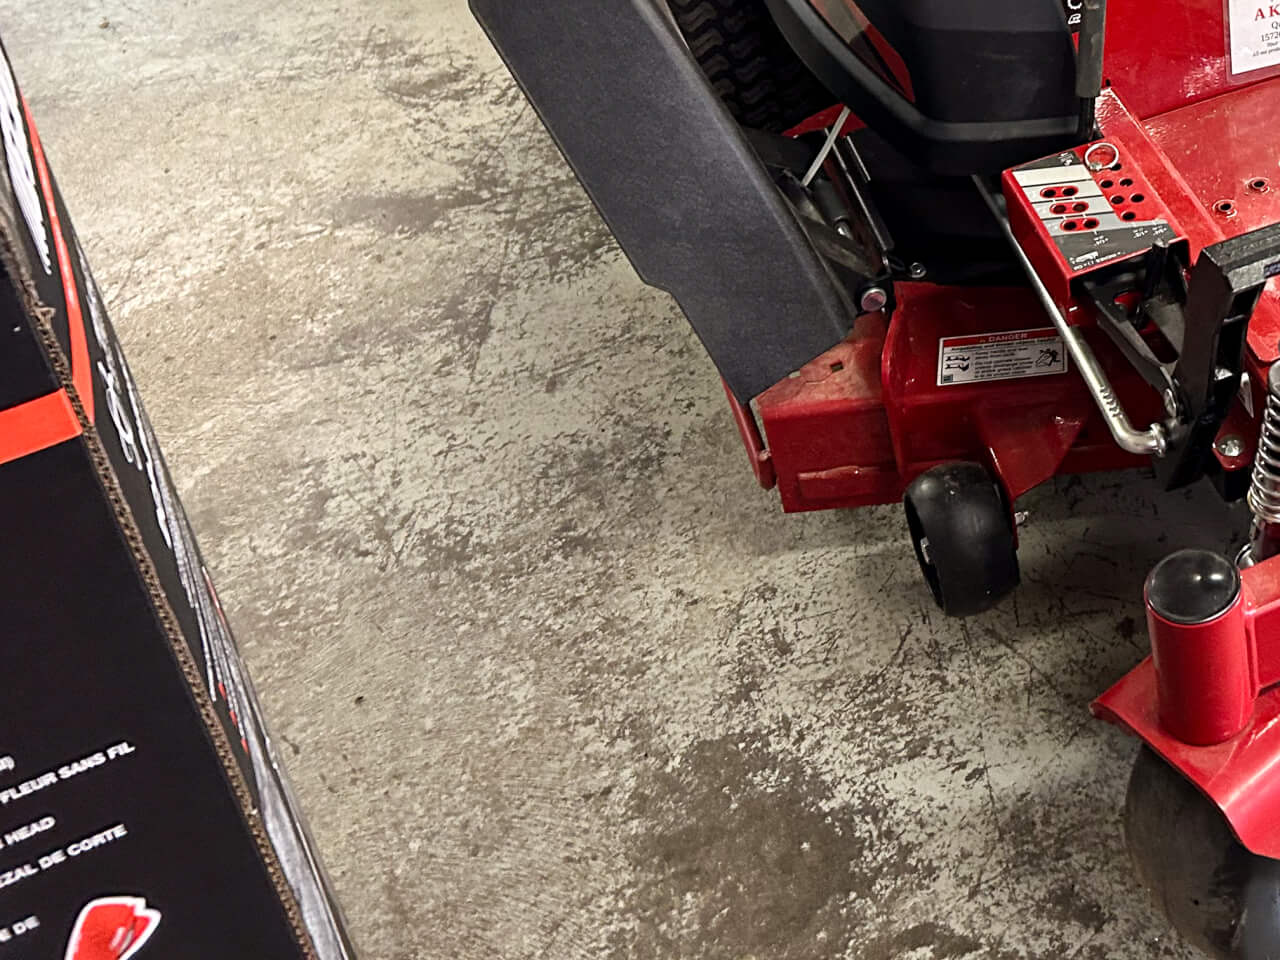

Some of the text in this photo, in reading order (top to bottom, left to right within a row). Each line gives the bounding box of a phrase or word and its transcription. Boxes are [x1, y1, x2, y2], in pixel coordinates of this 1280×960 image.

[1255, 8, 1265, 21] A
[1269, 4, 1280, 17] K
[989, 333, 1028, 342] DANGER
[58, 752, 106, 779] SANS
[106, 741, 135, 760] FIL
[4, 815, 56, 845] HEAD
[38, 823, 128, 870] DE CORTE
[13, 915, 40, 935] DE
